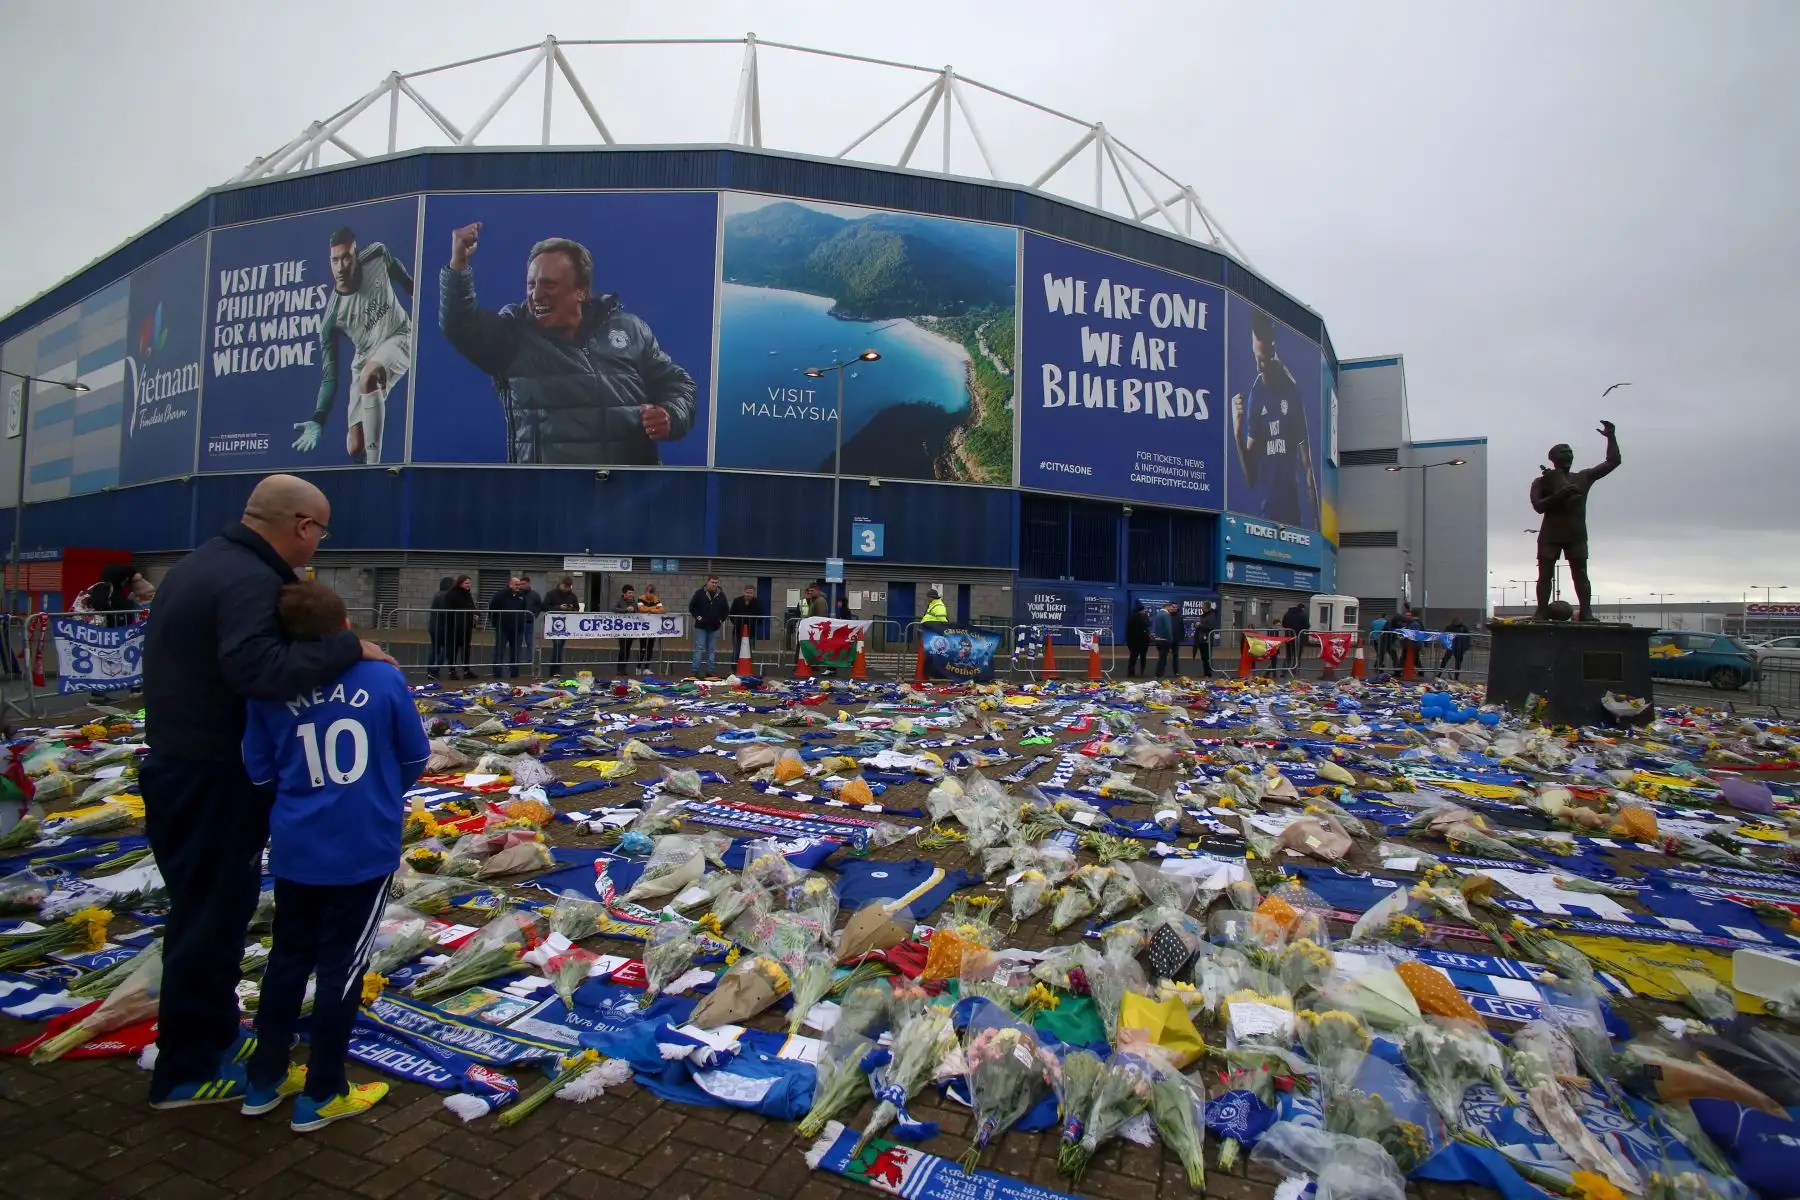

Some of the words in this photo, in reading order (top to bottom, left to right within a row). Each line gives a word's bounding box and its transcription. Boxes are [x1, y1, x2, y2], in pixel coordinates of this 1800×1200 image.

[221, 264, 269, 296] VISIT
[273, 259, 308, 286] THE
[216, 283, 328, 323] PHILIPPINES
[1043, 272, 1088, 316] WE
[1093, 278, 1146, 320] ARE
[1150, 293, 1208, 331] ONE
[214, 323, 245, 348] FOR
[248, 321, 257, 342] A
[260, 313, 321, 343] WARM
[213, 340, 317, 378] WELCOME
[1080, 325, 1124, 367] WE
[1131, 331, 1178, 371] ARE
[125, 356, 200, 439] Vietnam
[767, 386, 816, 404] VISIT
[1041, 363, 1211, 420] BLUEBIRDS
[163, 404, 188, 424] Charm
[741, 401, 839, 421] MALAYSIA
[208, 439, 269, 452] PHILIPPINES
[1039, 461, 1093, 476] #CITYASONE
[1134, 462, 1140, 471] &
[1141, 464, 1189, 478] INFORMATION
[1190, 470, 1207, 480] VISIT
[1136, 450, 1152, 461] FOR
[1153, 452, 1183, 467] TICKETS,
[1184, 459, 1205, 469] NEWS
[1130, 473, 1210, 492] CARDIFFCITYFC.CO.UK
[860, 529, 876, 553] 3
[1243, 522, 1278, 540] TICKET
[1280, 530, 1311, 546] OFFICE
[1027, 602, 1045, 611] YOUR
[1046, 603, 1067, 612] TICKET
[1031, 611, 1048, 619] YOUR
[1048, 612, 1062, 621] WAY
[57, 621, 120, 646] CARDIFF
[579, 618, 650, 631] CF38ers
[72, 647, 94, 674] 8
[123, 645, 140, 672] 9
[945, 662, 981, 675] brothers
[285, 683, 370, 717] MEAD
[296, 718, 368, 788] 10
[1485, 999, 1533, 1020] FC
[348, 1040, 453, 1083] CARDIFF
[935, 1173, 978, 1192] BLAKE
